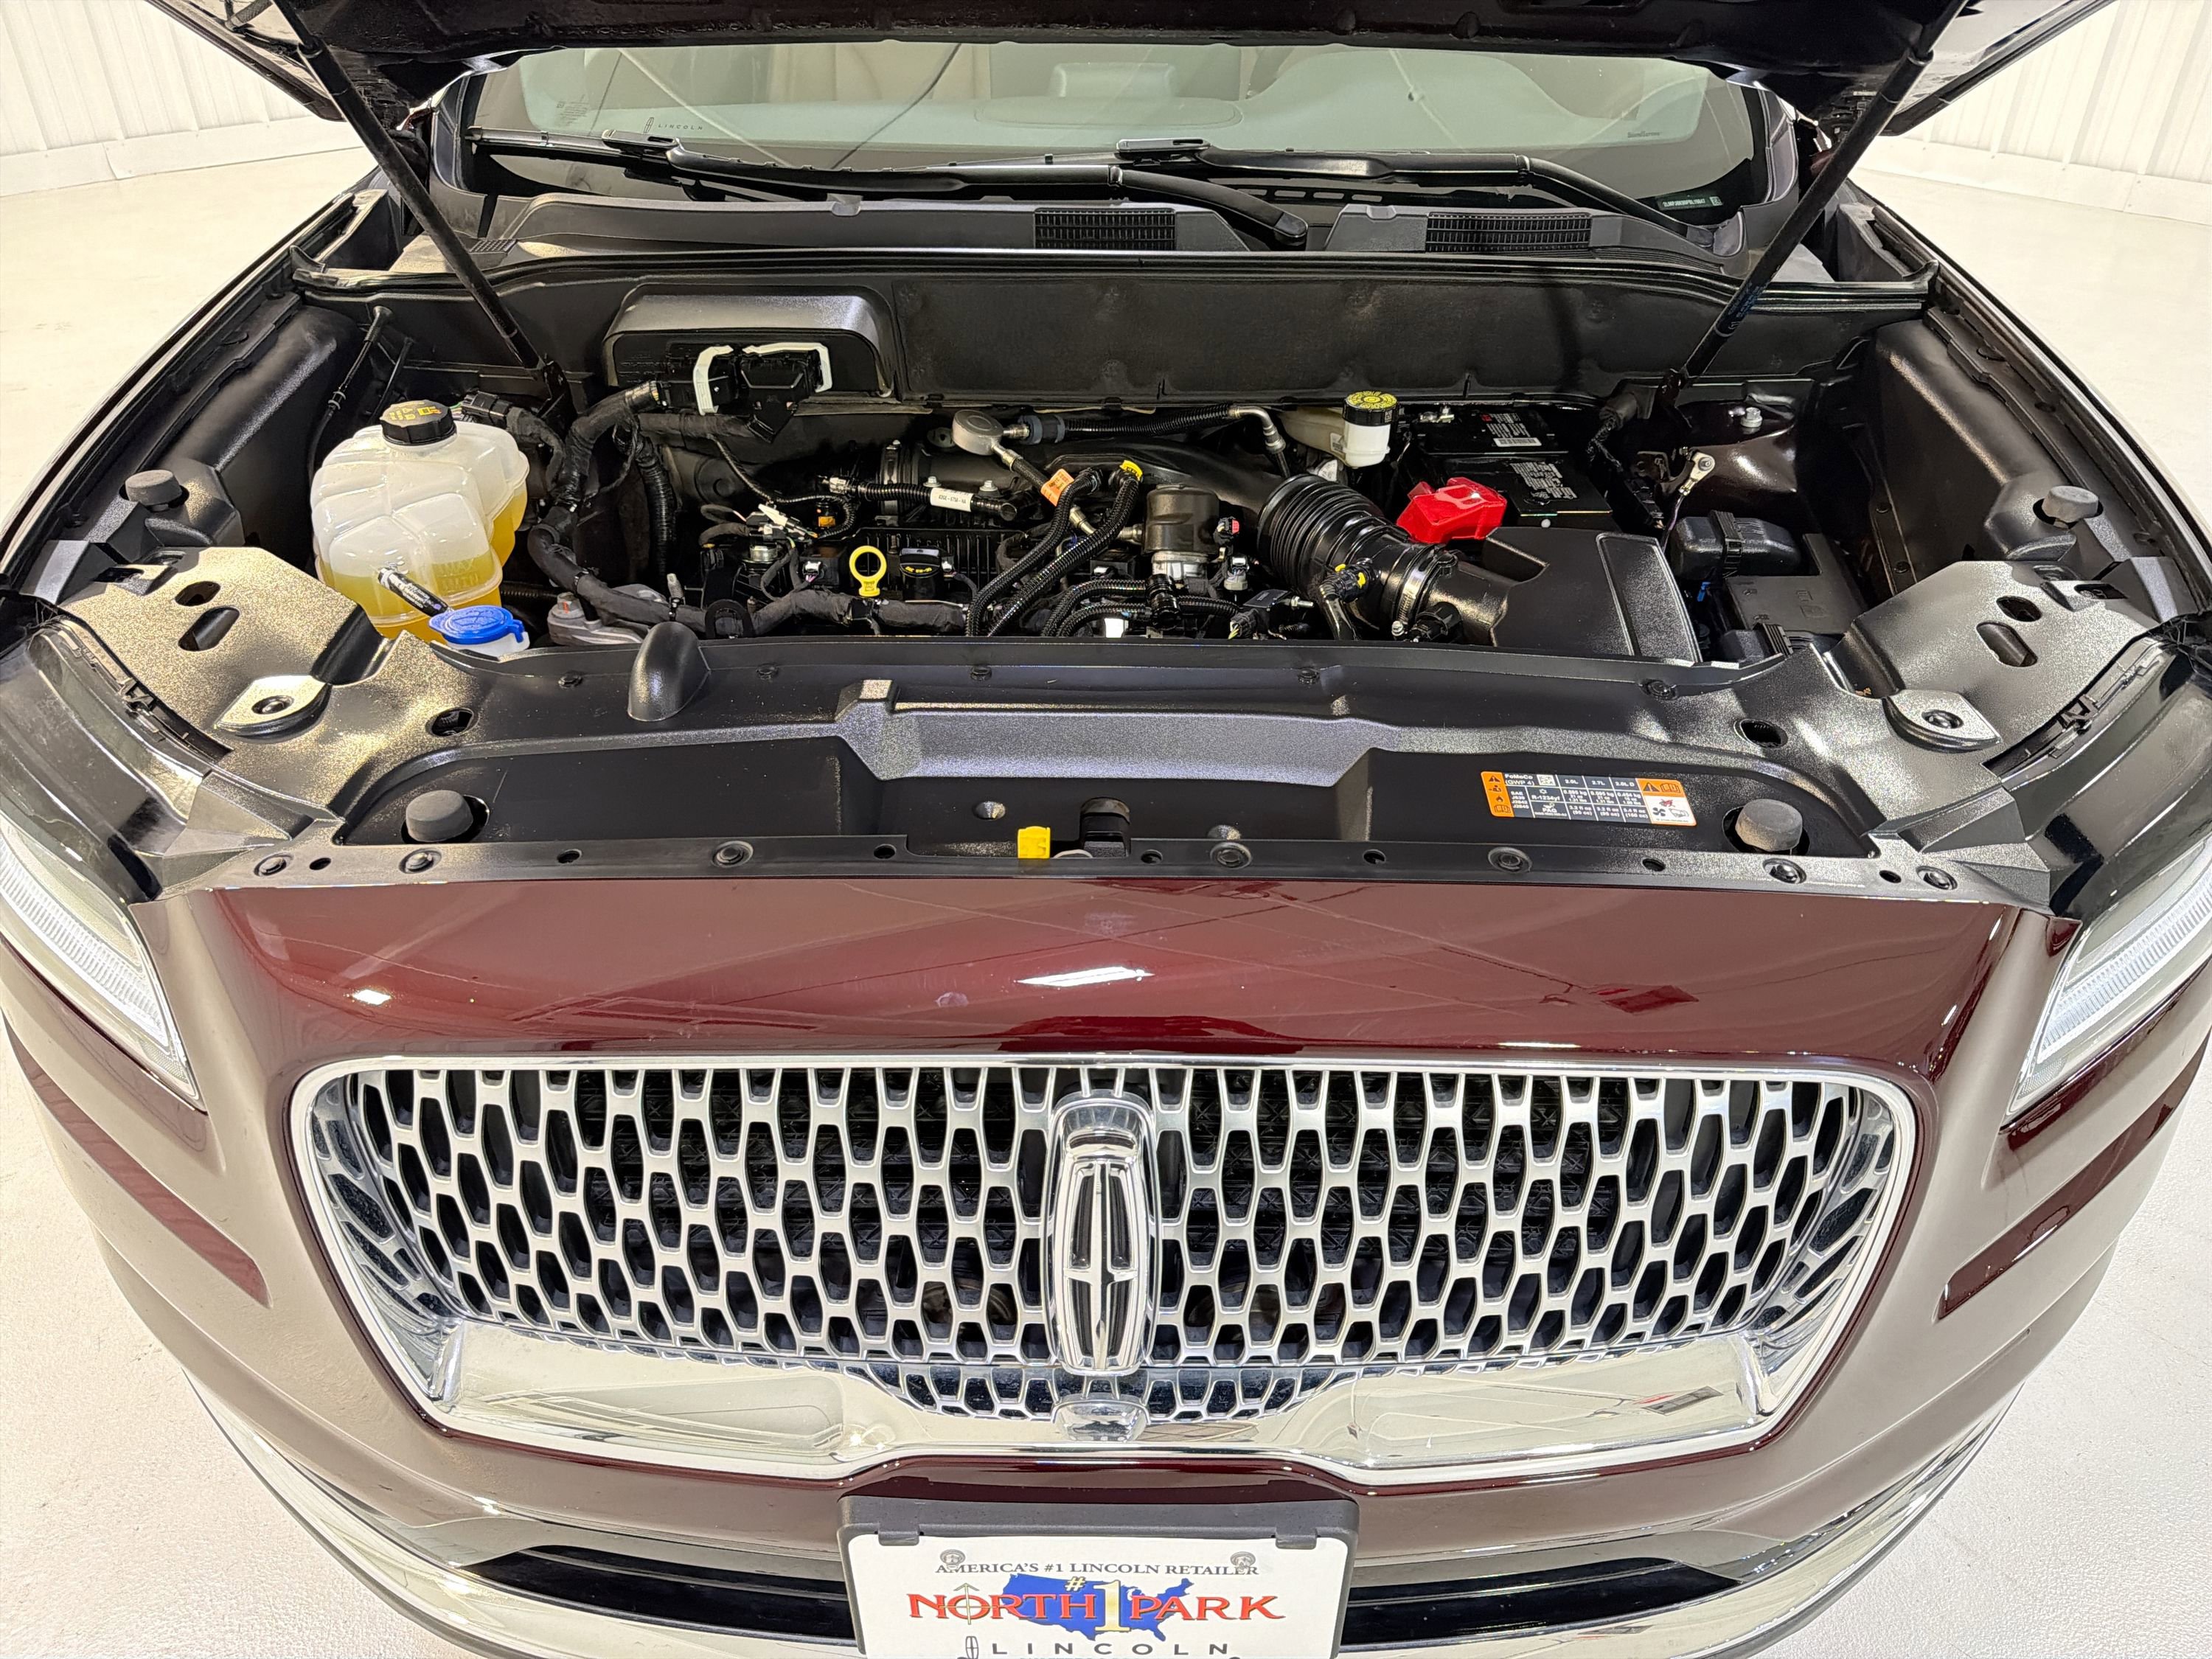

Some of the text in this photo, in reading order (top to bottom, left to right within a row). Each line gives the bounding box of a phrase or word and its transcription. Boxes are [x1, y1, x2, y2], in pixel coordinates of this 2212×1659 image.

[934, 1562, 1039, 1573] AMERICA'S
[1044, 1563, 1064, 1573] #1
[1069, 1563, 1161, 1574] LINCOLN
[907, 1593, 1287, 1621] NORTH PARK
[992, 1642, 1228, 1656] LINCOLN
